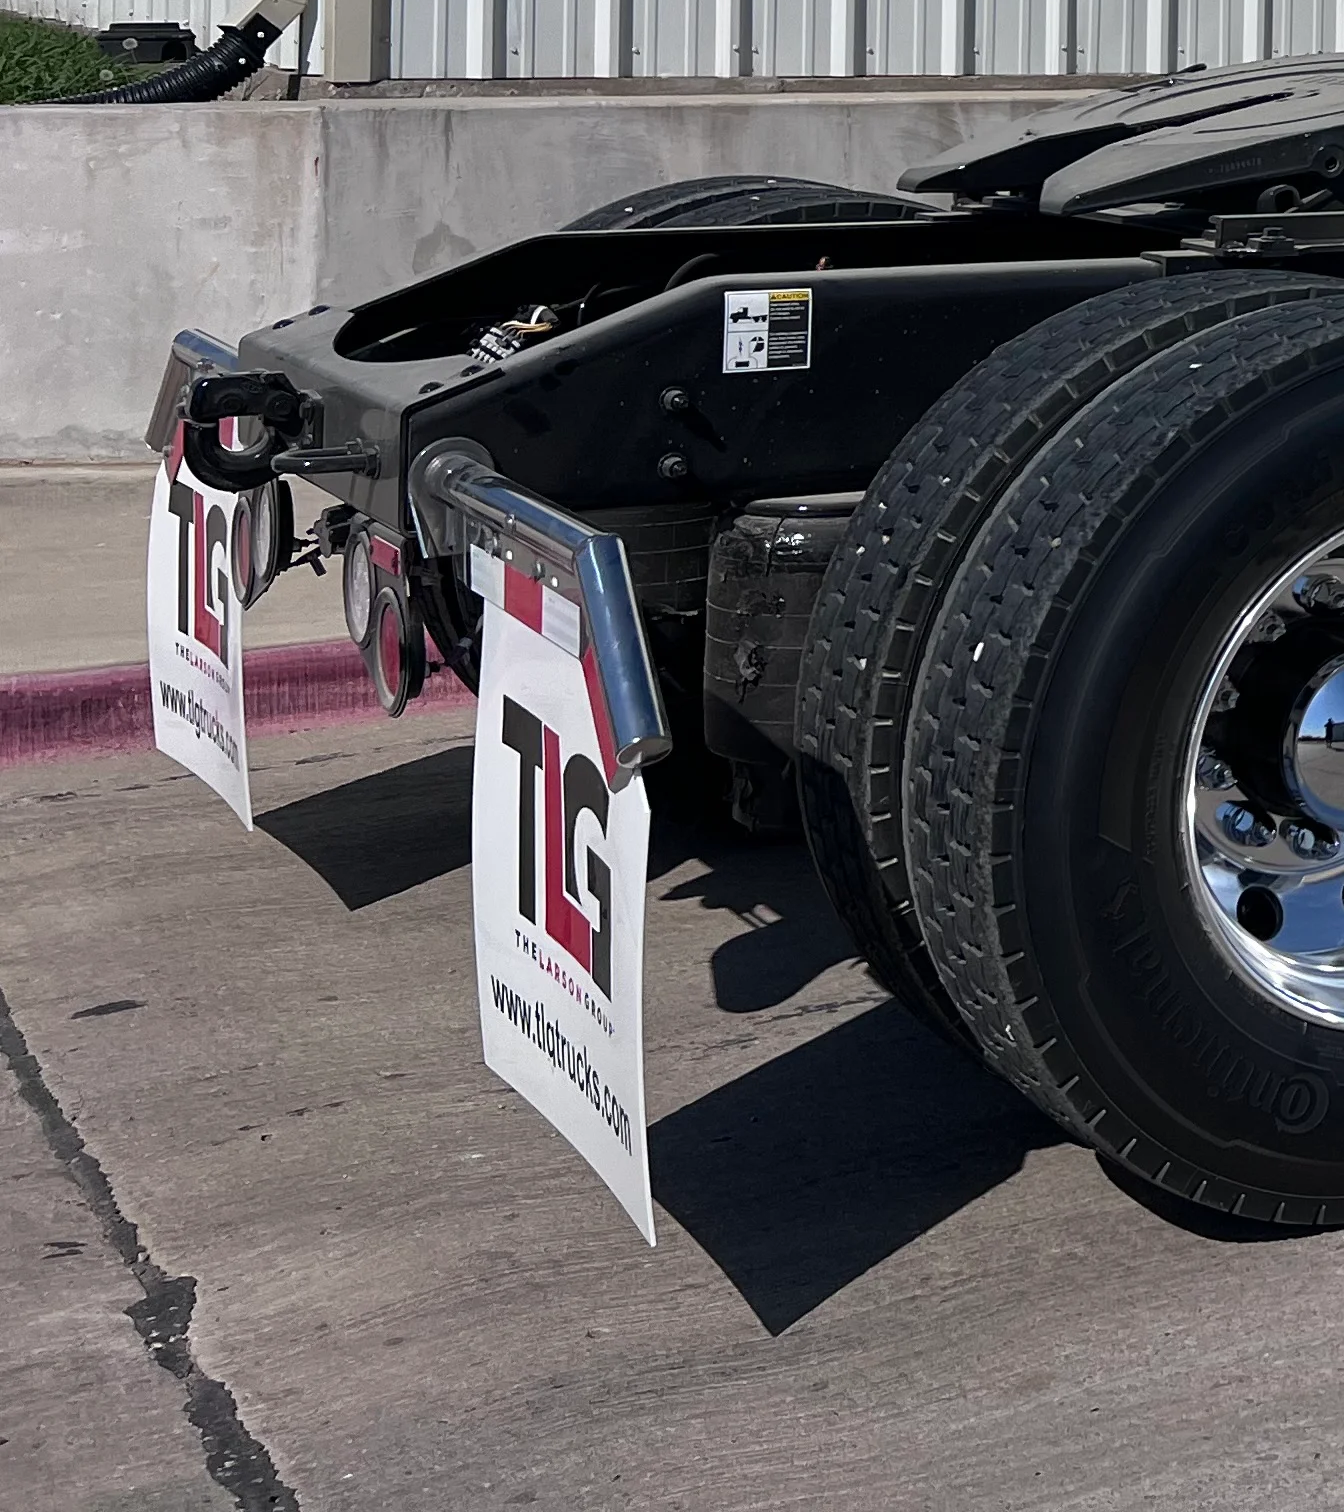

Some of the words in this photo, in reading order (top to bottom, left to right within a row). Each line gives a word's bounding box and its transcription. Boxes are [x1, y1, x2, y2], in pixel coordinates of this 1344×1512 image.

[776, 292, 808, 300] CAUTION
[169, 479, 229, 671] TLG
[502, 694, 613, 1003] TLG
